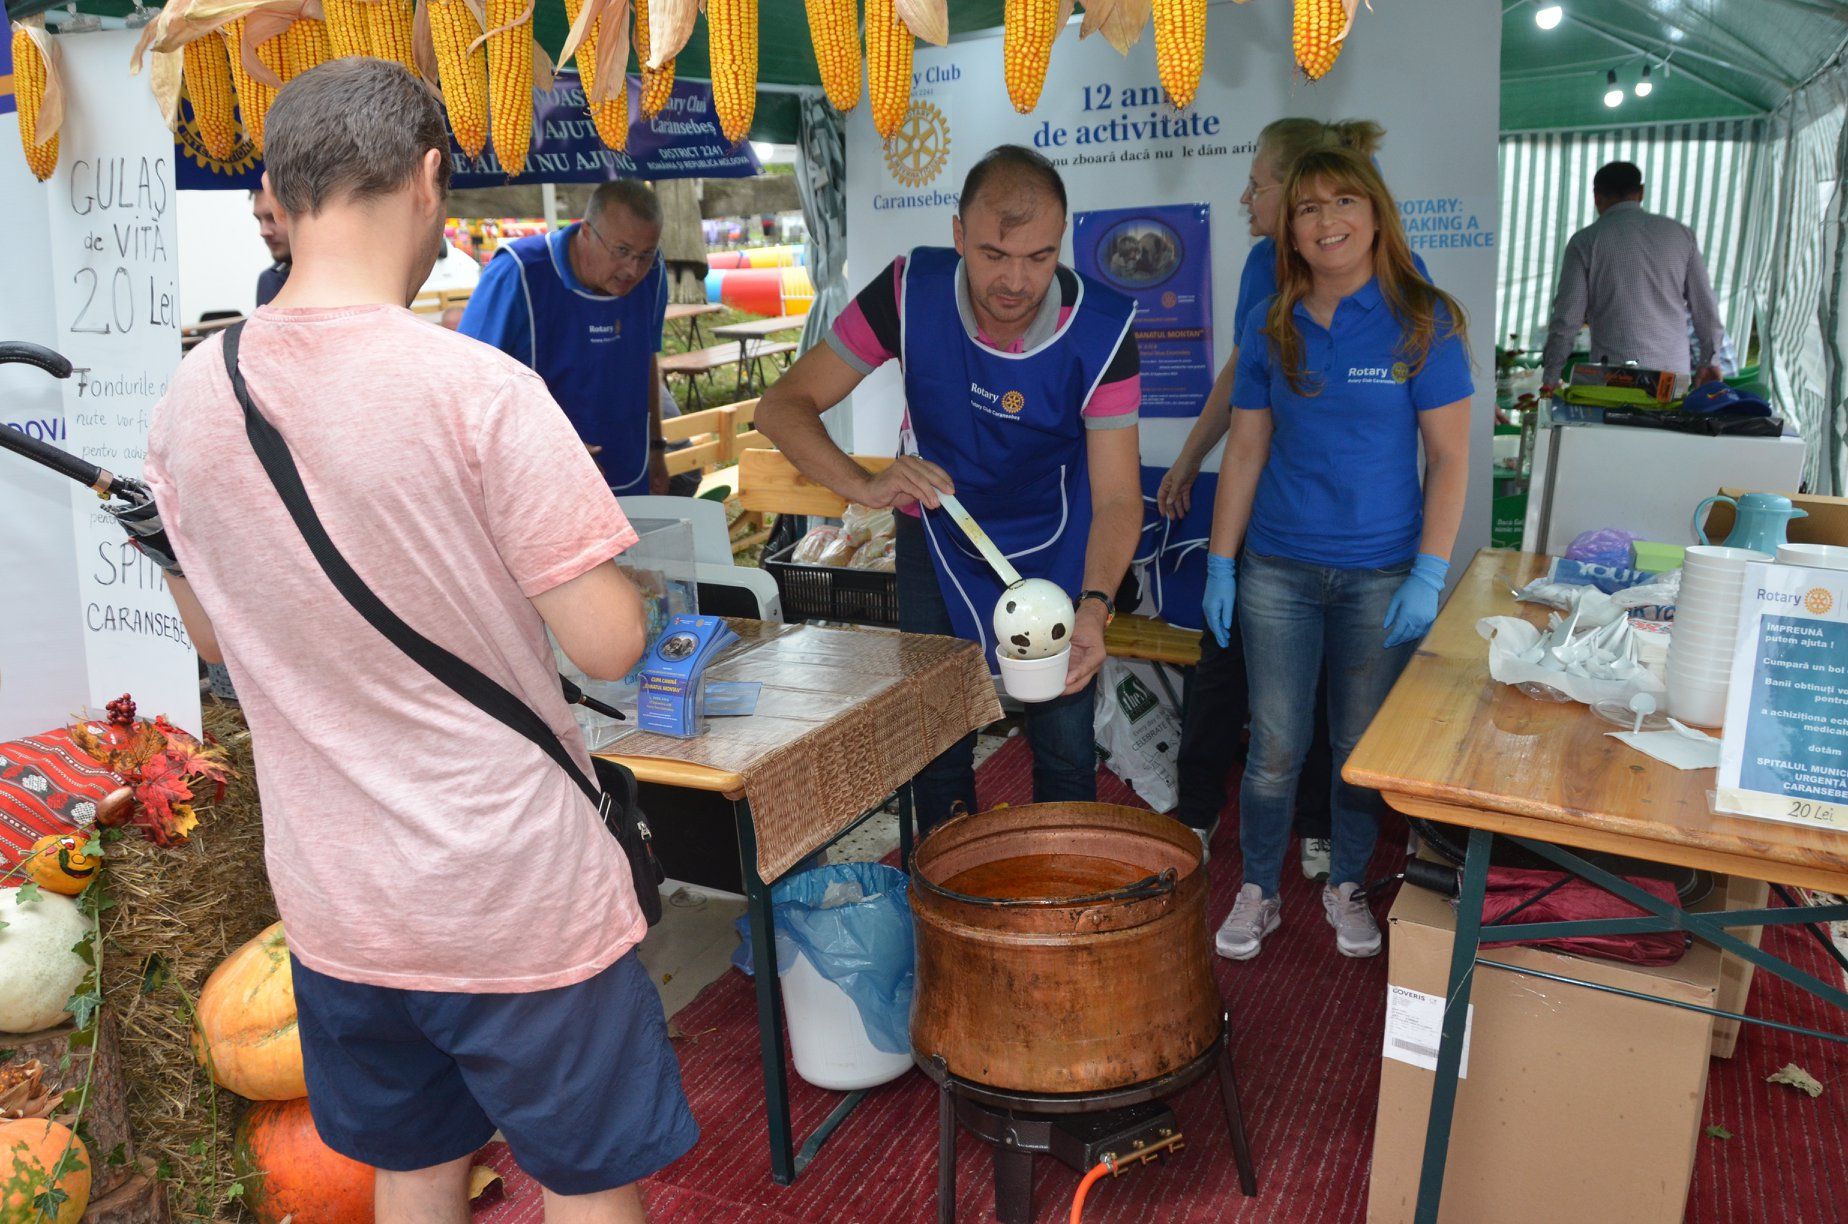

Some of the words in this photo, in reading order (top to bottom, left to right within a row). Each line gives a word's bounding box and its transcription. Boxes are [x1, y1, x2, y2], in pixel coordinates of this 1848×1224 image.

[926, 64, 961, 84] Club
[1082, 83, 1112, 112] 12
[1033, 121, 1068, 148] de
[1075, 111, 1221, 145] activitate
[659, 146, 699, 160] DISTRICT
[700, 144, 724, 157] 2241
[1072, 150, 1117, 166] zboară
[1120, 148, 1151, 163] dacă
[1155, 149, 1174, 160] nu
[1182, 146, 1194, 158] le
[1198, 143, 1228, 157] dăm
[536, 153, 570, 174] NU
[1466, 215, 1479, 229] A
[84, 232, 104, 251] de
[1408, 232, 1494, 248] FFERENCE
[70, 266, 134, 334] 20
[150, 276, 176, 328] Lei
[1348, 367, 1388, 378] Rotary
[72, 367, 156, 398] Fondurile
[971, 383, 999, 404] Rotary
[1757, 588, 1801, 606] Rotary
[1765, 634, 1798, 645] putem
[1800, 638, 1828, 649] ajuta
[1812, 663, 1825, 671] un
[1828, 664, 1845, 674] bol
[1765, 677, 1792, 688] Banii
[1838, 687, 1848, 695] vo
[1761, 707, 1768, 715] a
[1830, 716, 1848, 726] ech
[1132, 720, 1168, 752] CELEBRATE
[1808, 743, 1842, 756] dotăm
[1756, 757, 1808, 772] SPITALUL
[1810, 764, 1848, 778] MUNICI
[1783, 782, 1848, 799] CARANSEBE
[1788, 801, 1811, 818] 20
[1814, 805, 1834, 822] Lei
[1393, 988, 1425, 1001] COVERIS
